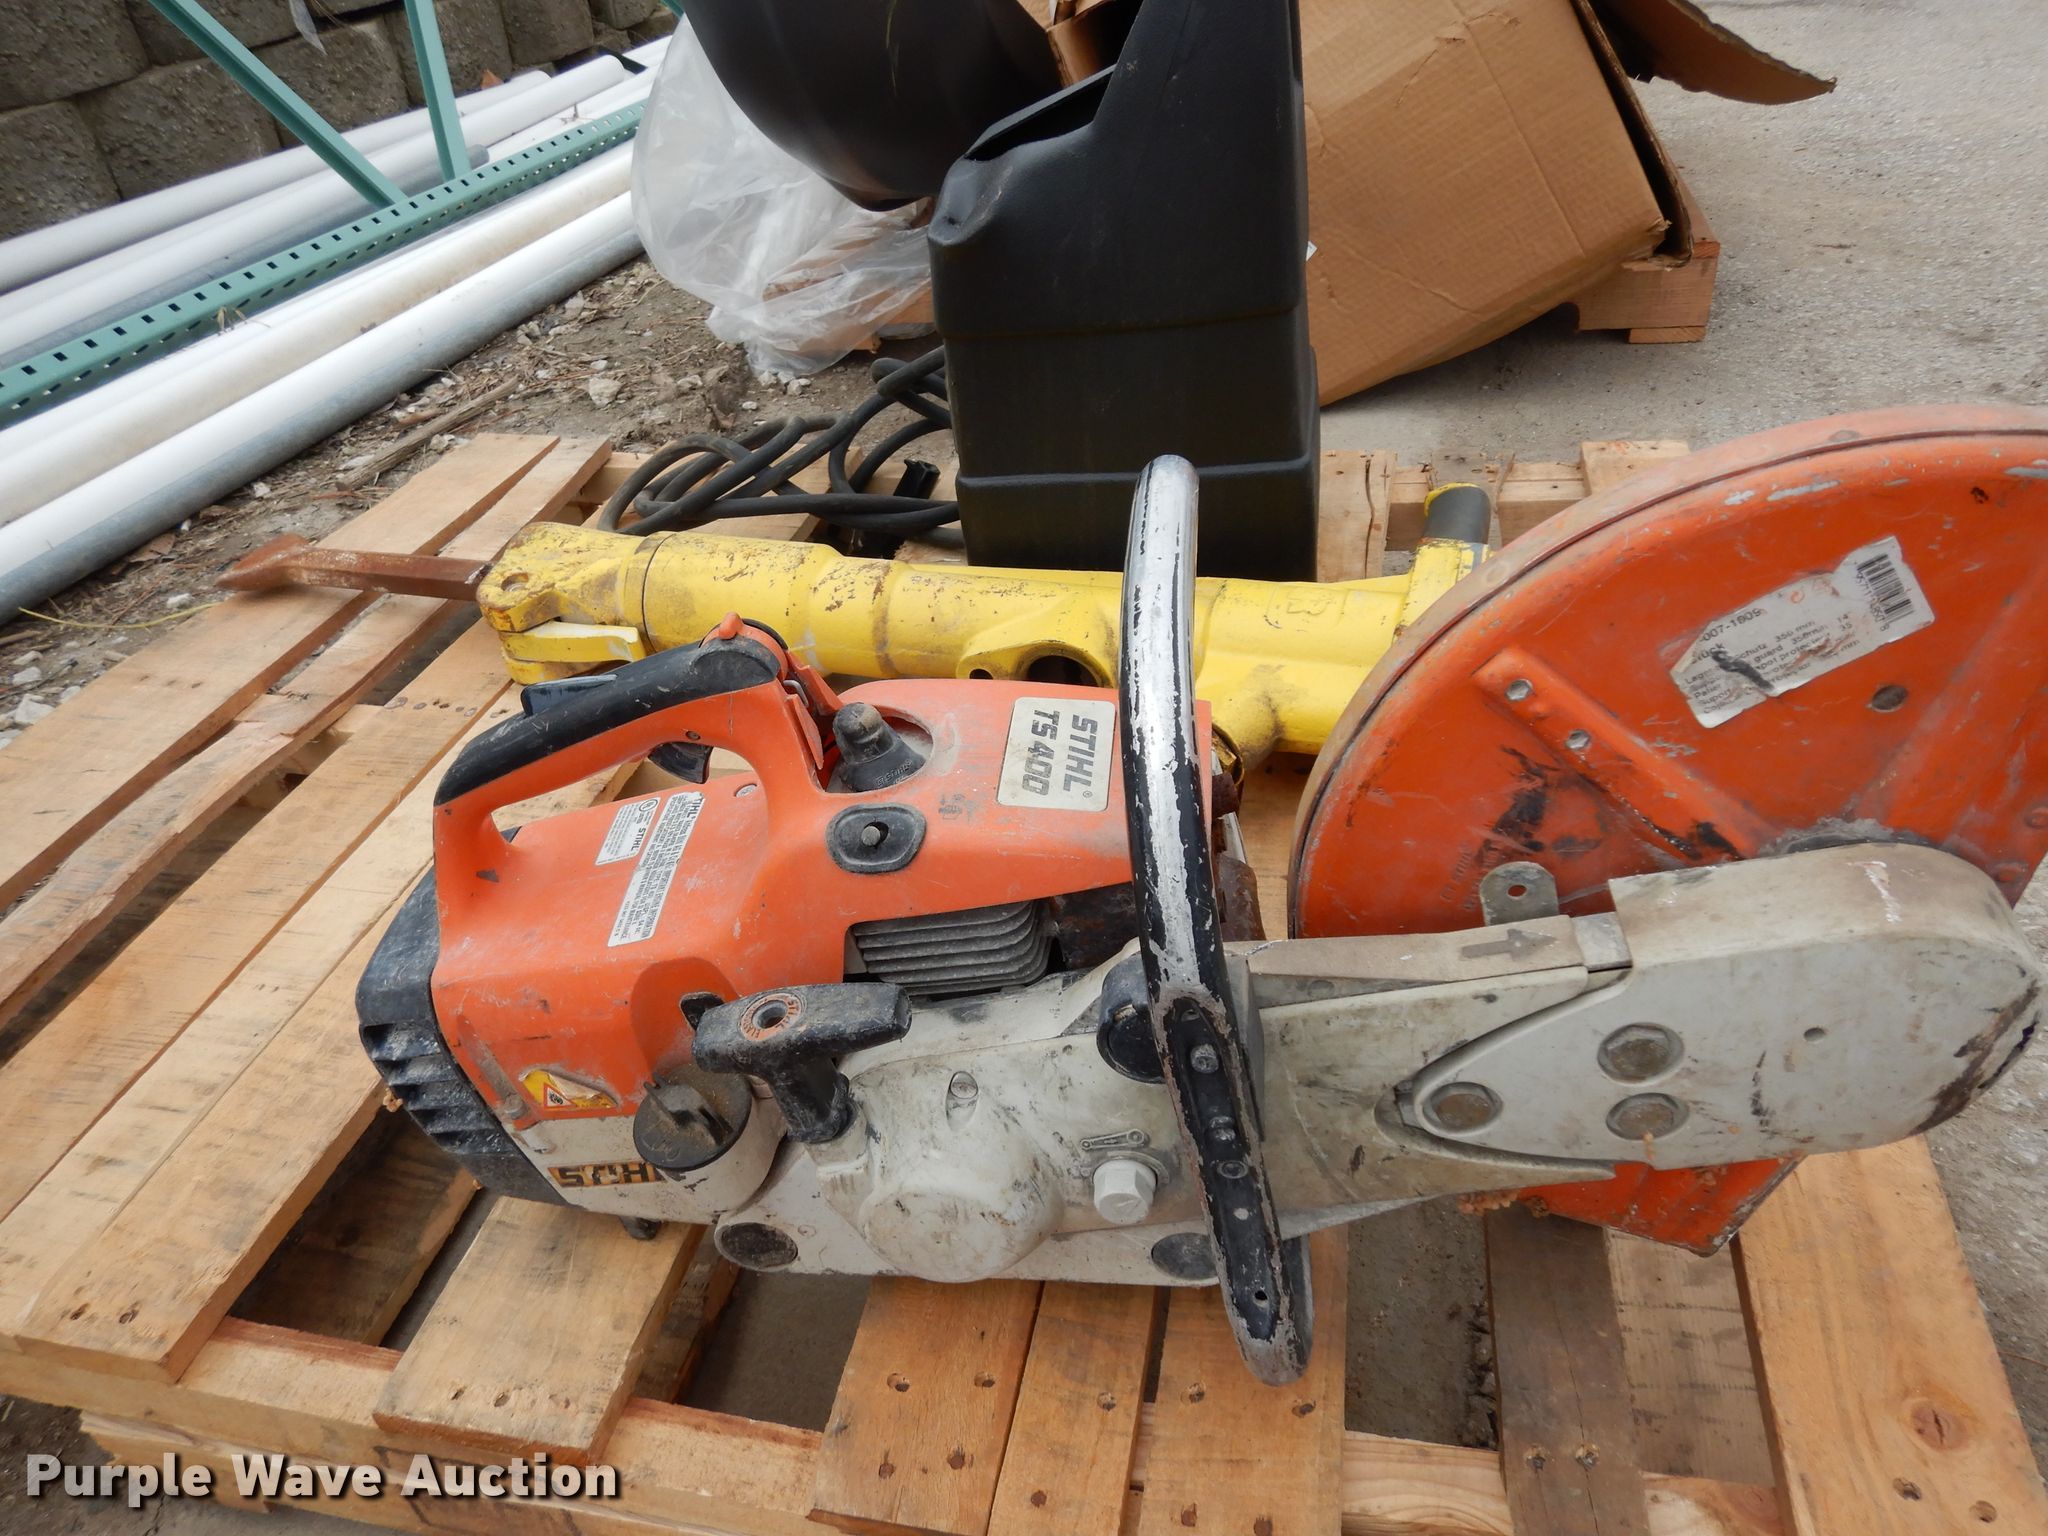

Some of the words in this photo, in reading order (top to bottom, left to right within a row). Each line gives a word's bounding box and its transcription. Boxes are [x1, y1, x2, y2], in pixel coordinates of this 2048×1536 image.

[1752, 643, 1784, 663] guard
[1031, 709, 1060, 741] TS
[1022, 741, 1055, 796] 400
[1063, 714, 1098, 792] STIHL
[630, 828, 646, 850] STIHL
